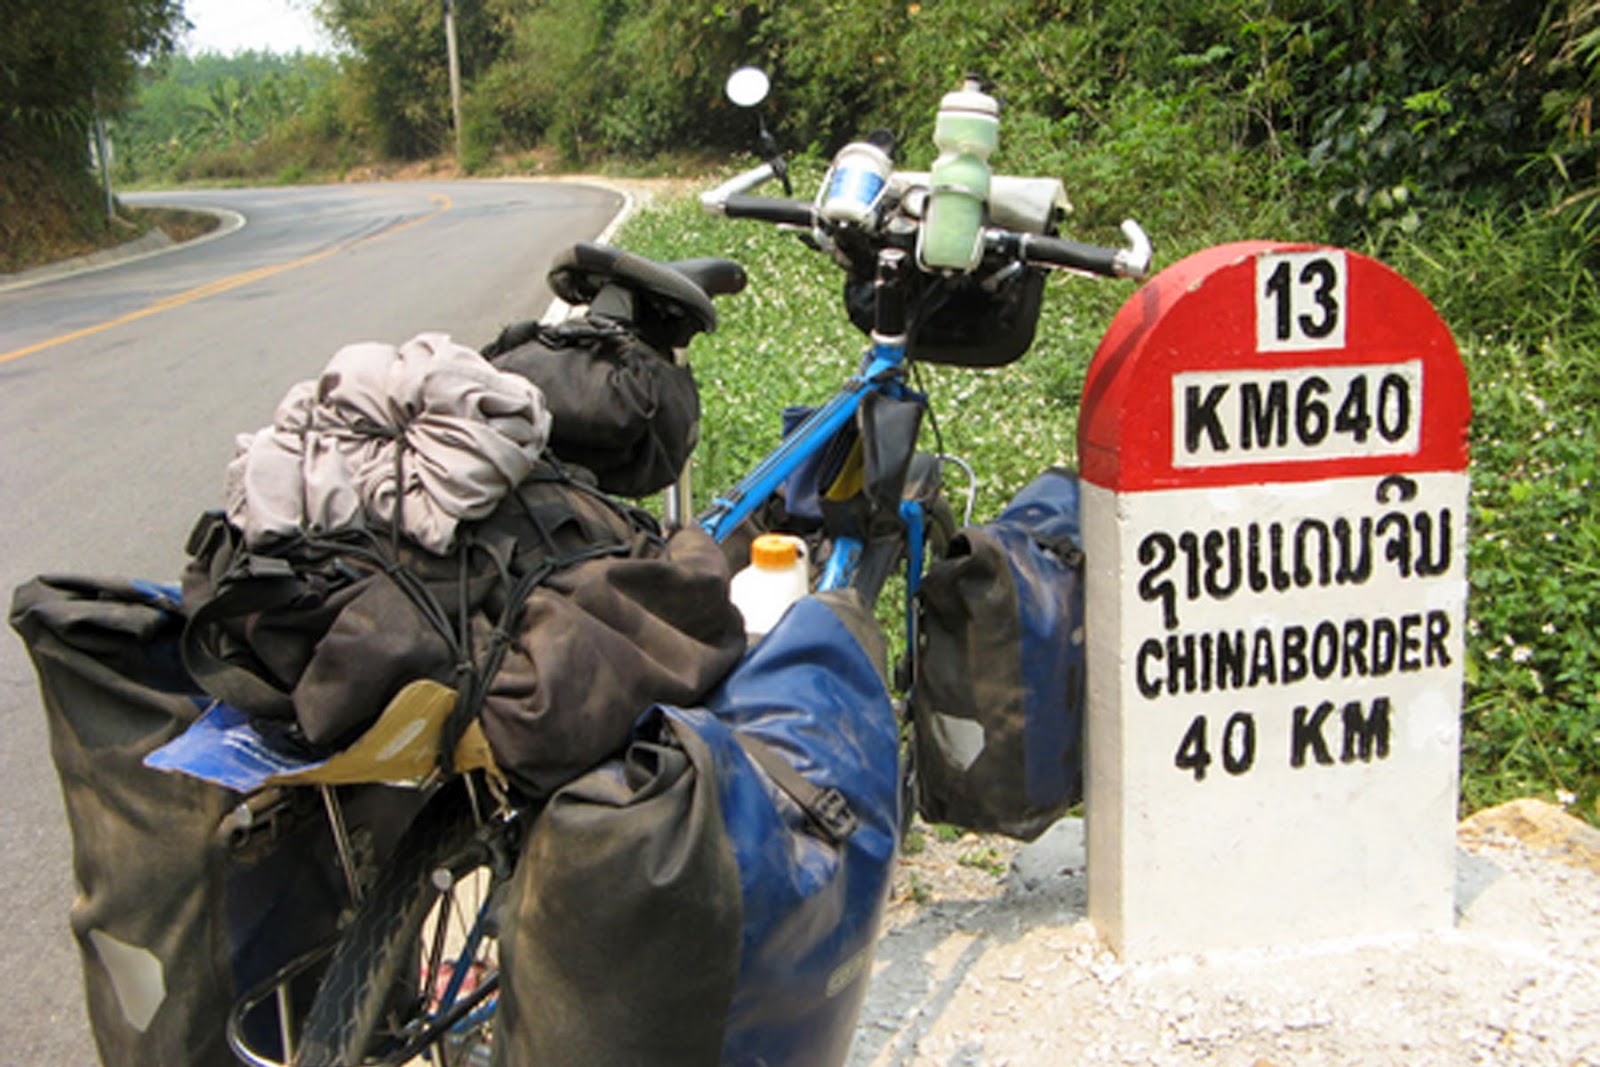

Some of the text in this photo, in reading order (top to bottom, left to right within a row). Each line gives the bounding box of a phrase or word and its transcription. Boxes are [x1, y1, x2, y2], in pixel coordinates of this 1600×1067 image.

[1265, 258, 1339, 342] 13
[1184, 373, 1411, 453] KM640
[1175, 697, 1391, 780] 40 KM
